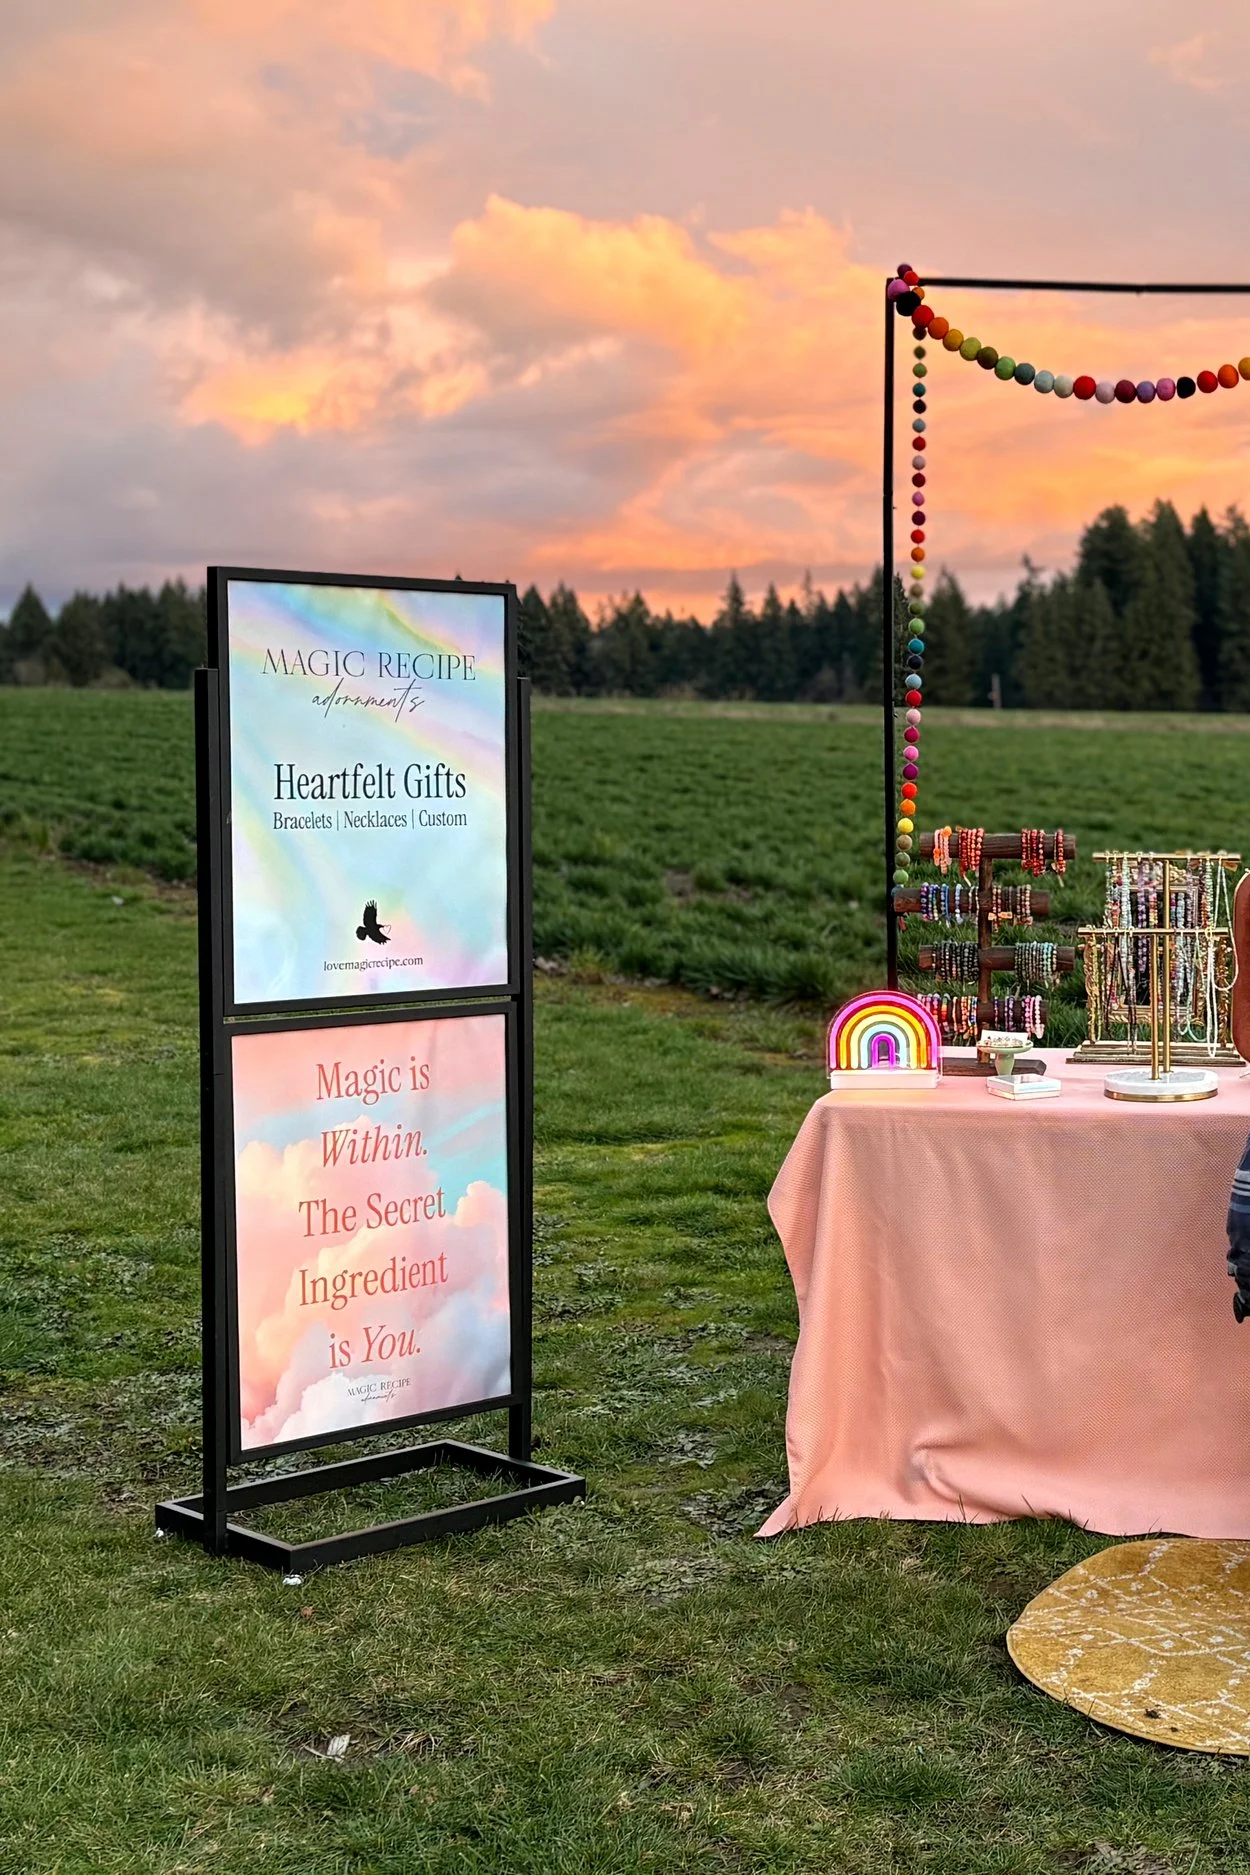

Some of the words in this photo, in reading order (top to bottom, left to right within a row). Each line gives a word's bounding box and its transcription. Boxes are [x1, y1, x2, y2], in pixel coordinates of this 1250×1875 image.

[262, 648, 365, 677] MAGIC
[378, 652, 476, 681] RECIPE
[312, 678, 425, 722] adornments
[274, 763, 395, 800] Heartfelt
[403, 762, 467, 799] Gifts
[273, 811, 332, 830] Bracelets
[343, 810, 408, 829] Necklaces
[418, 809, 467, 827] Custom
[323, 955, 423, 972] lovemagicrecipe.com
[316, 1059, 401, 1105] Magic
[409, 1056, 430, 1090] is
[321, 1124, 428, 1168] Within.
[299, 1199, 357, 1237] The
[366, 1187, 446, 1230] Secret
[299, 1251, 449, 1310] Ingredient
[329, 1333, 351, 1369] is
[361, 1324, 421, 1362] You.
